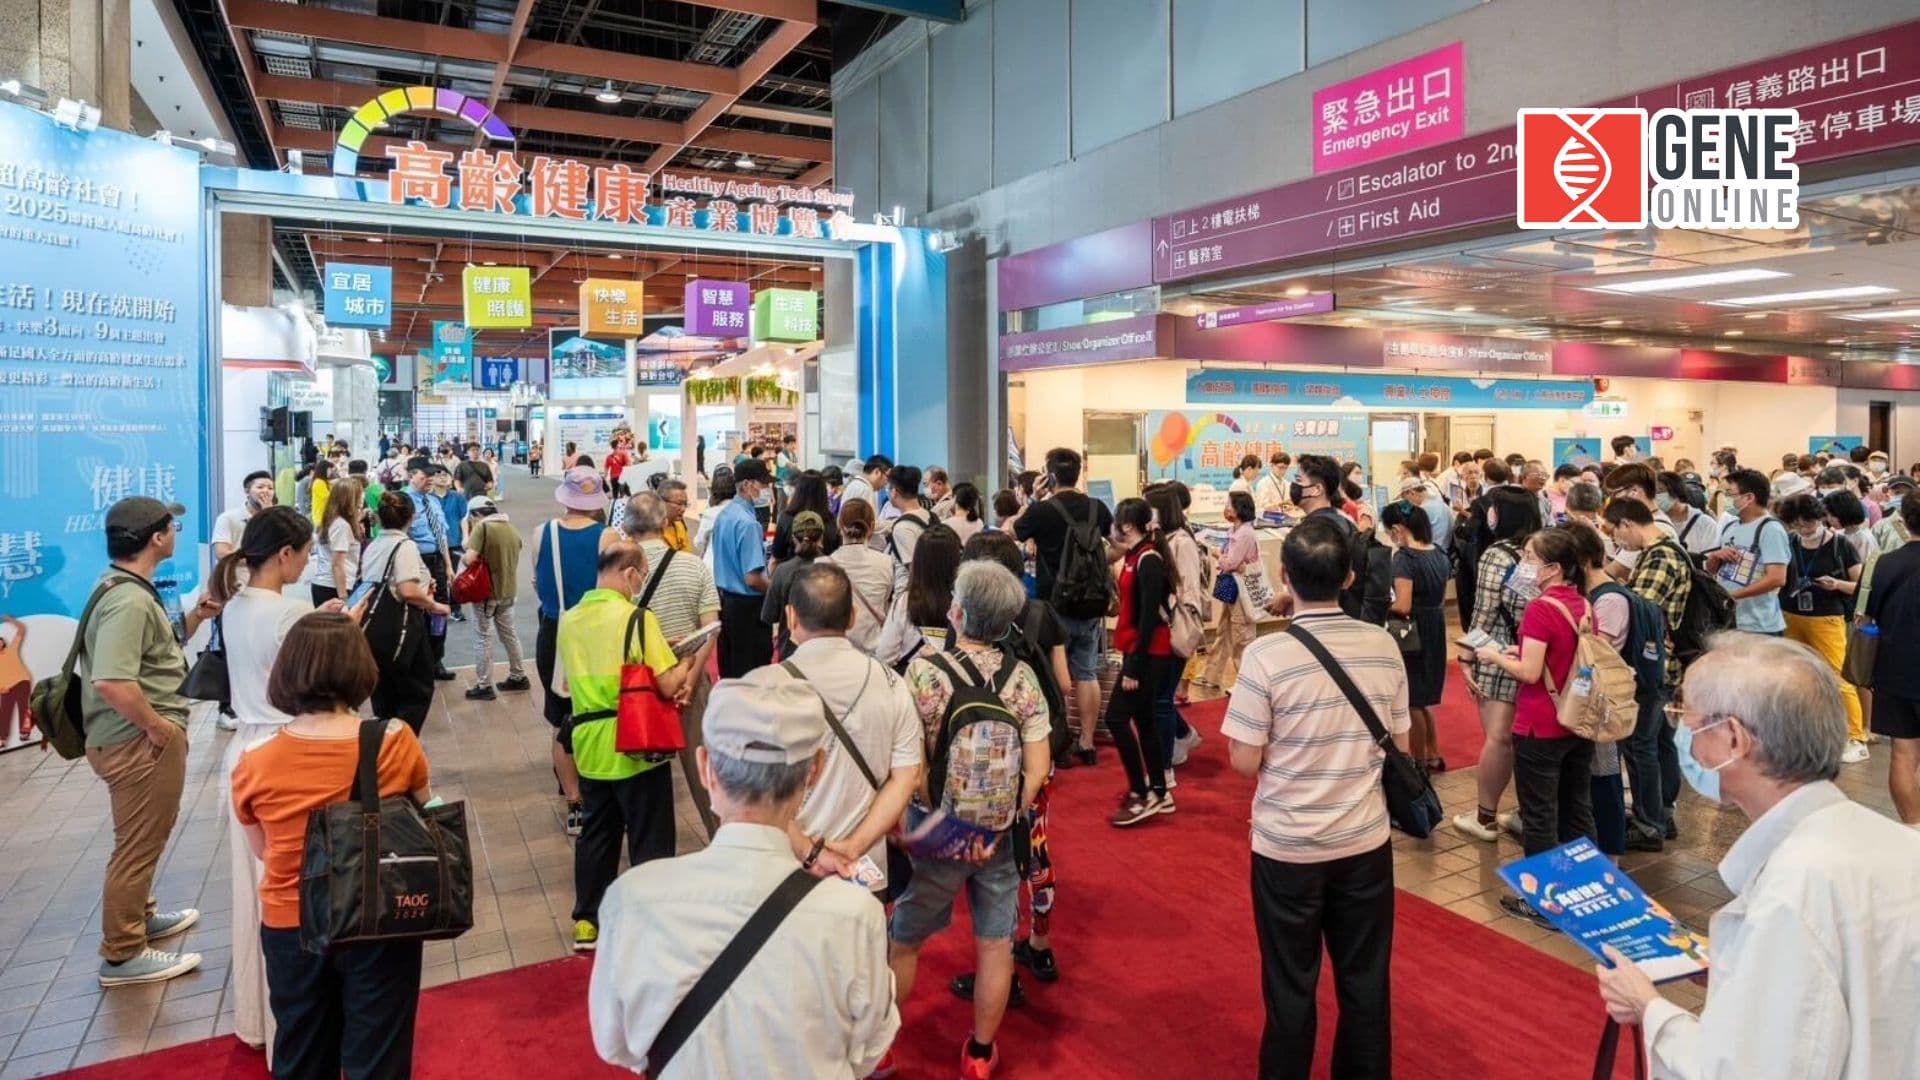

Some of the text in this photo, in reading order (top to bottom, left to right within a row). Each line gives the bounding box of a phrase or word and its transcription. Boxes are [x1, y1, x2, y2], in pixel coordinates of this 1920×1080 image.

[1725, 47, 1885, 110] 信義路出口
[1322, 66, 1451, 137] 緊急出口
[1322, 104, 1450, 157] Emergency Exit
[386, 140, 651, 226] 高齡健康
[1358, 159, 1446, 196] Escalator
[1456, 151, 1477, 172] to
[662, 173, 855, 207] Healthy Ageing Tech Show
[1358, 196, 1441, 233] First Aid
[1188, 244, 1224, 266] 醫務室
[331, 271, 373, 291] 宜居
[472, 274, 512, 296] 健康
[344, 296, 386, 317] 城市
[593, 286, 628, 305] 快樂
[701, 287, 734, 307] 智慧
[775, 294, 805, 312] 生活
[486, 298, 526, 319] 照護
[604, 305, 639, 327] 生活
[712, 308, 745, 328] 服務
[783, 314, 814, 333] 科技
[90, 462, 176, 511] 健康
[64, 513, 107, 534] HEA
[395, 893, 430, 908] TAOG
